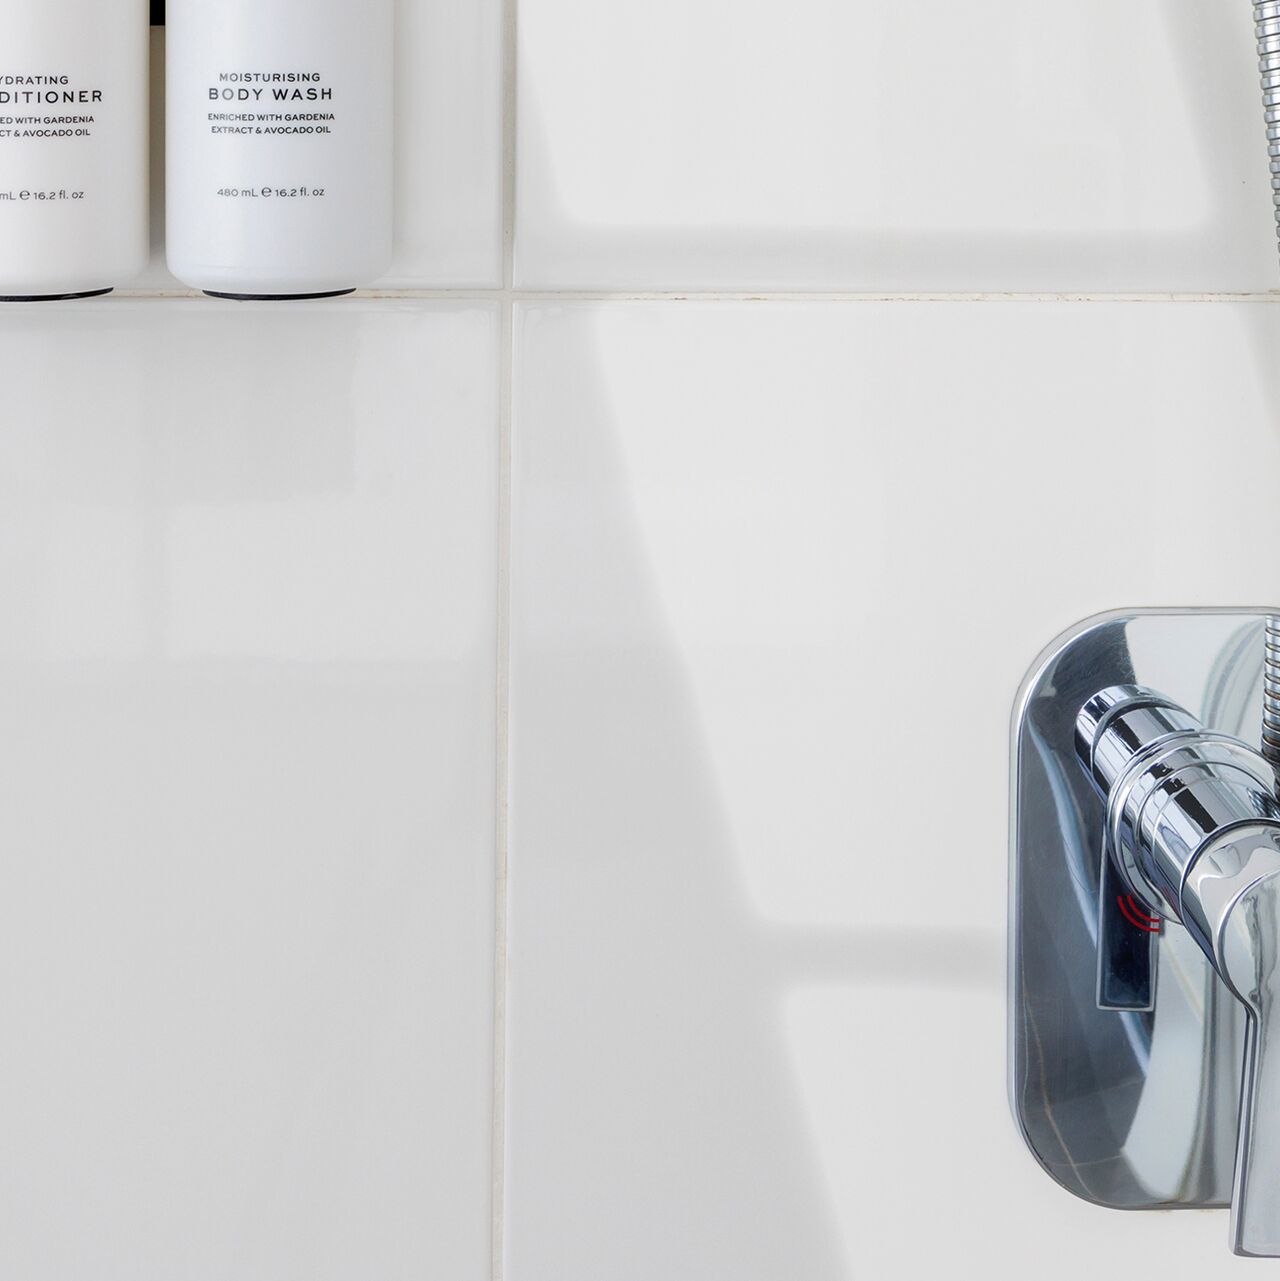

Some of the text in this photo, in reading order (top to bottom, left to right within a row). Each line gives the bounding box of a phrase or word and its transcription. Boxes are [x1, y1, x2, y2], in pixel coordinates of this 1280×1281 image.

[219, 72, 321, 83] MOISTURISING
[208, 88, 332, 101] BODY WASH
[15, 116, 41, 124] WITH
[43, 116, 94, 124] GARDENIA
[208, 113, 335, 121] ENRICHED WITH GARDENIA
[13, 129, 20, 137] &
[22, 129, 73, 137] AVOCADO
[75, 129, 91, 137] OIL
[211, 126, 331, 134] EXTRACT & AVOCADO OIL
[0, 192, 16, 201] mL
[33, 192, 56, 201] 16.2
[71, 192, 84, 200] oz
[217, 189, 239, 198] 480
[241, 189, 258, 198] mL
[275, 189, 297, 198] 16.2
[312, 189, 325, 197] oz
